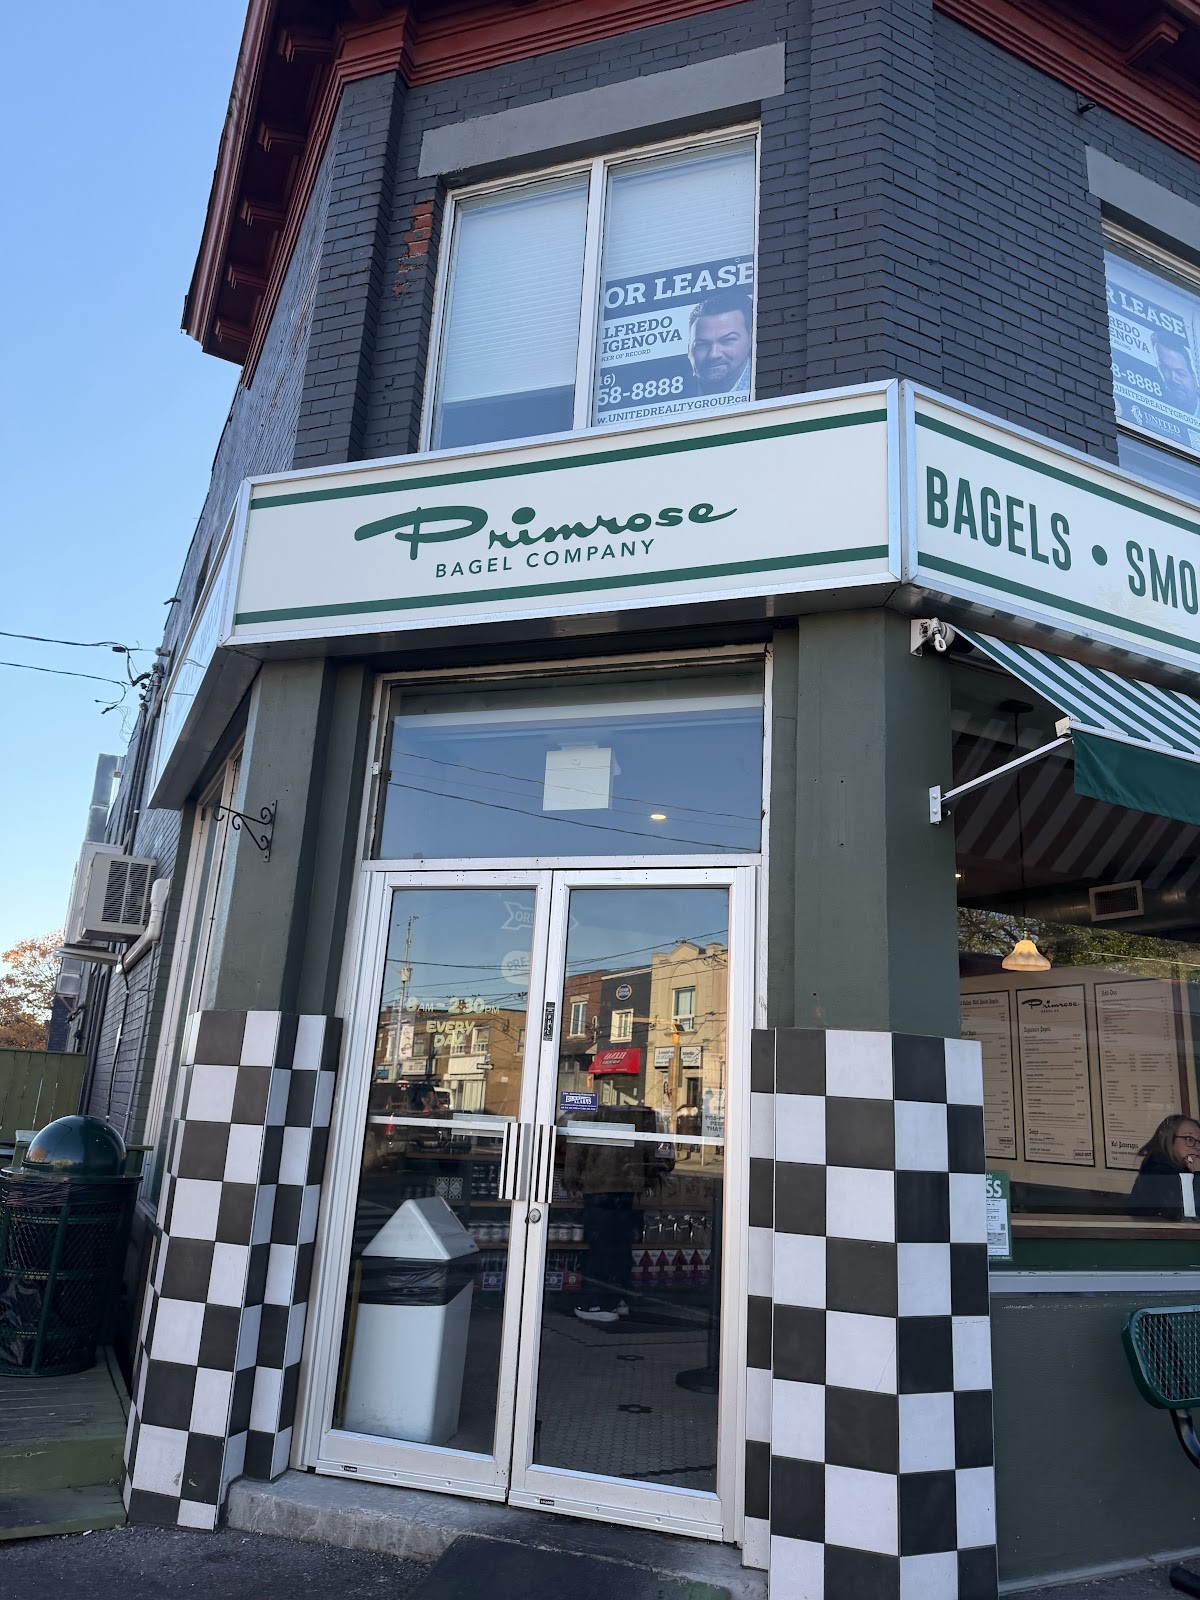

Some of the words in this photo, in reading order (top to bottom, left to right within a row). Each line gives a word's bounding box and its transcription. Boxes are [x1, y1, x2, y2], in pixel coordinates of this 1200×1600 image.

[605, 282, 646, 309] OR
[653, 261, 754, 300] LEASE
[1119, 291, 1186, 338] LEASE
[601, 328, 683, 354] IGENOVA
[603, 316, 673, 340] LFREDO
[625, 349, 651, 357] RECORD
[597, 375, 684, 406] 58-8888
[1144, 412, 1181, 434] UNITED
[354, 503, 737, 560] Primrose
[926, 465, 1072, 571] BAGELS
[1125, 540, 1199, 615] SMO
[435, 556, 513, 578] BAGEL
[526, 538, 656, 568] COMPANY
[1021, 998, 1081, 1010] Primrose
[426, 1020, 475, 1036] EVERY
[433, 1034, 464, 1048] DAY
